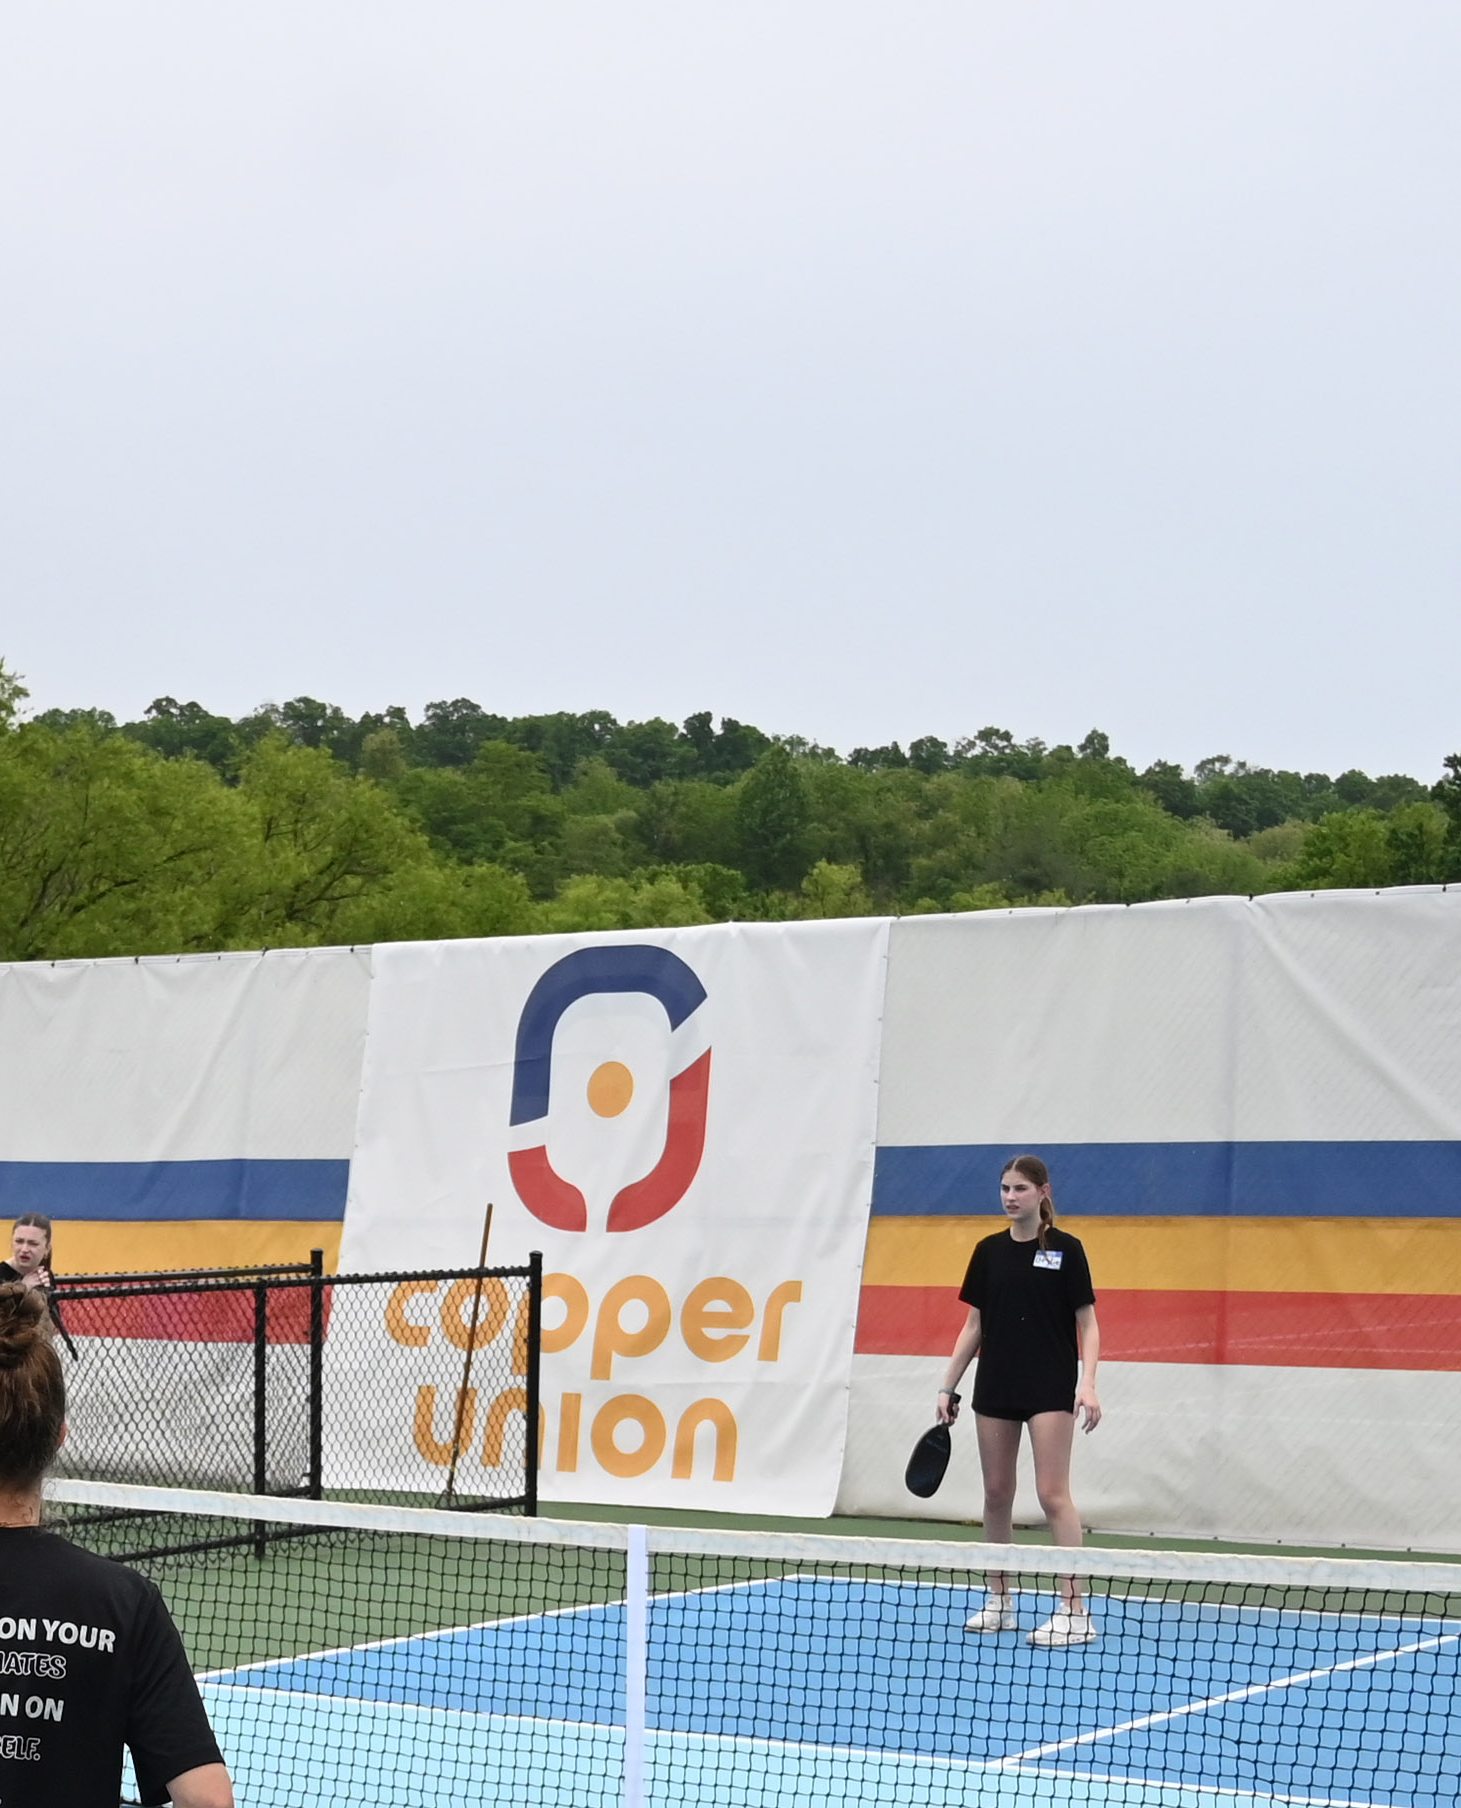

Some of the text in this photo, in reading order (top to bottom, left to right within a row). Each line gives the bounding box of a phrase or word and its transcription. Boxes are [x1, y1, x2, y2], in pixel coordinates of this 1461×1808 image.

[412, 1385, 738, 1482] union
[42, 1619, 116, 1653] YOUR
[26, 1696, 65, 1722] ON
